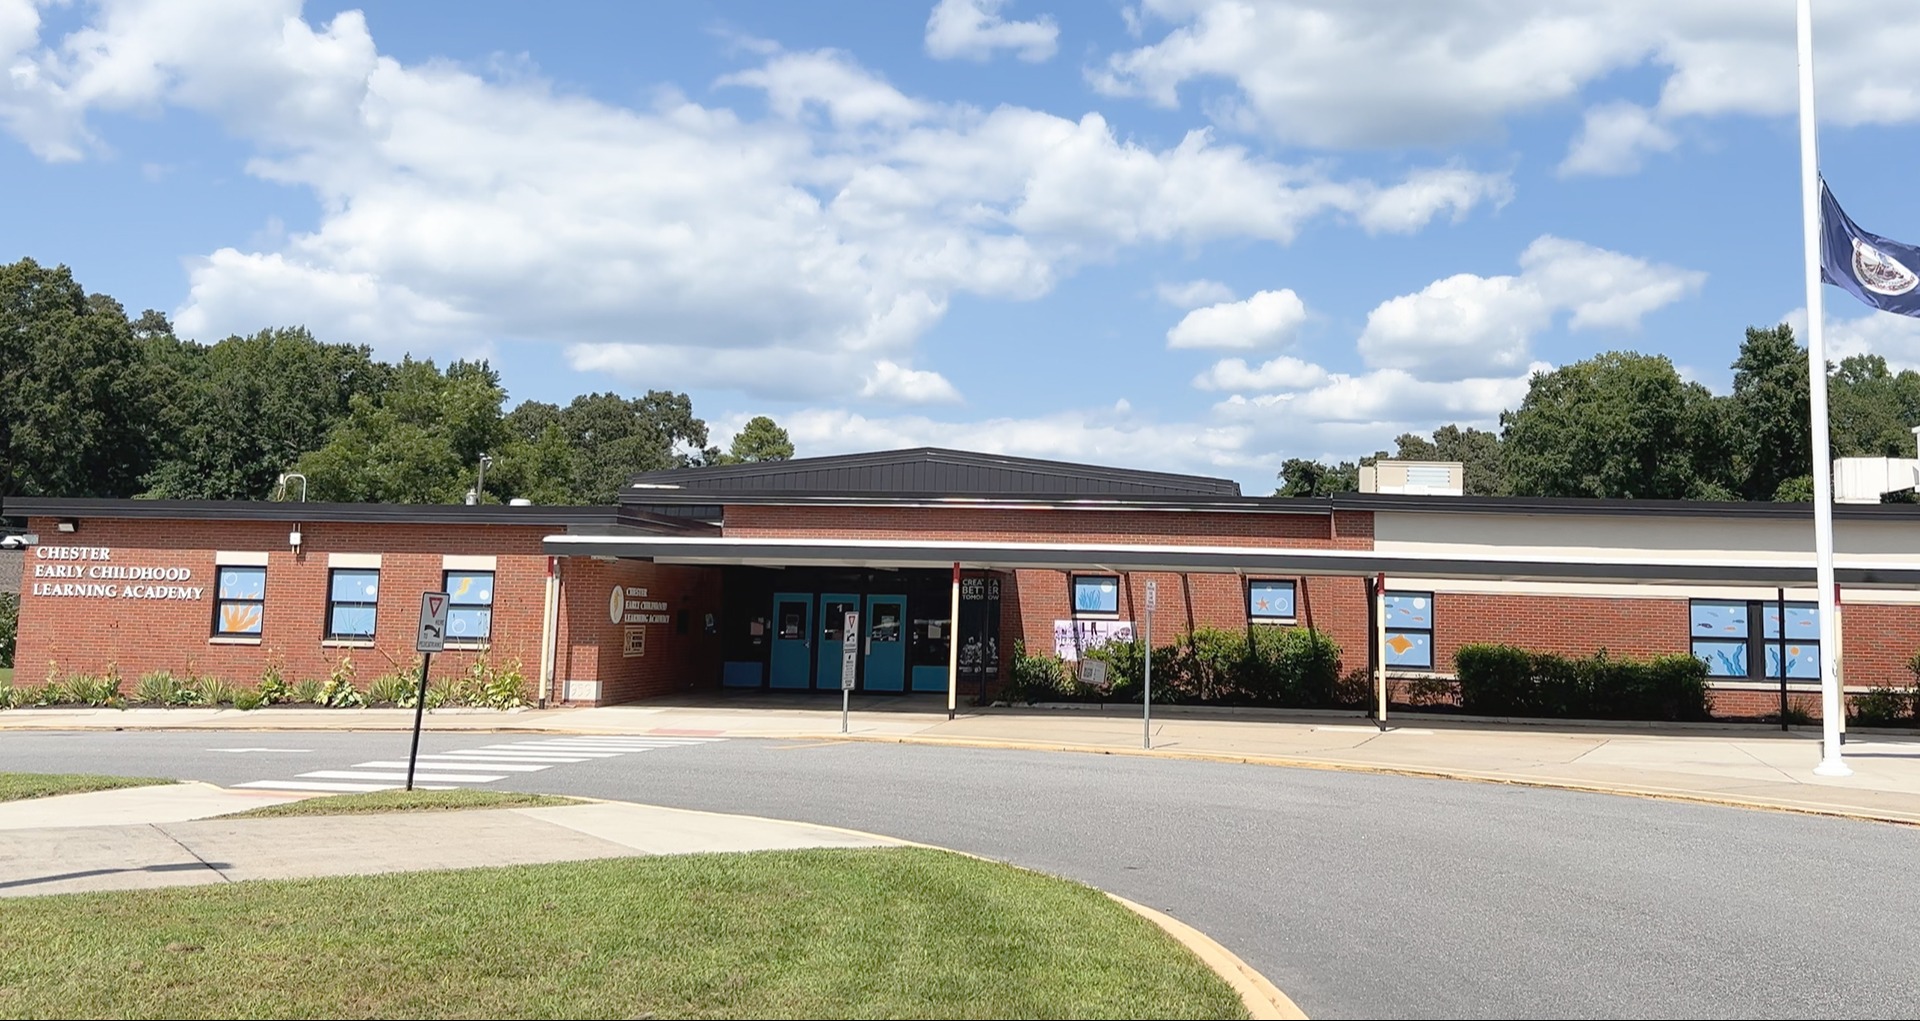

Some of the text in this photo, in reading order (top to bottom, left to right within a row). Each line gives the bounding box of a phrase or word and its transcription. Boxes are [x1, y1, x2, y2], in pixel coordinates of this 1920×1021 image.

[36, 546, 111, 561] CHESTER
[35, 565, 191, 581] EARLY CHILDHOOD
[33, 584, 203, 600] LEARNING ACADEMY
[626, 587, 648, 597] CHESTER
